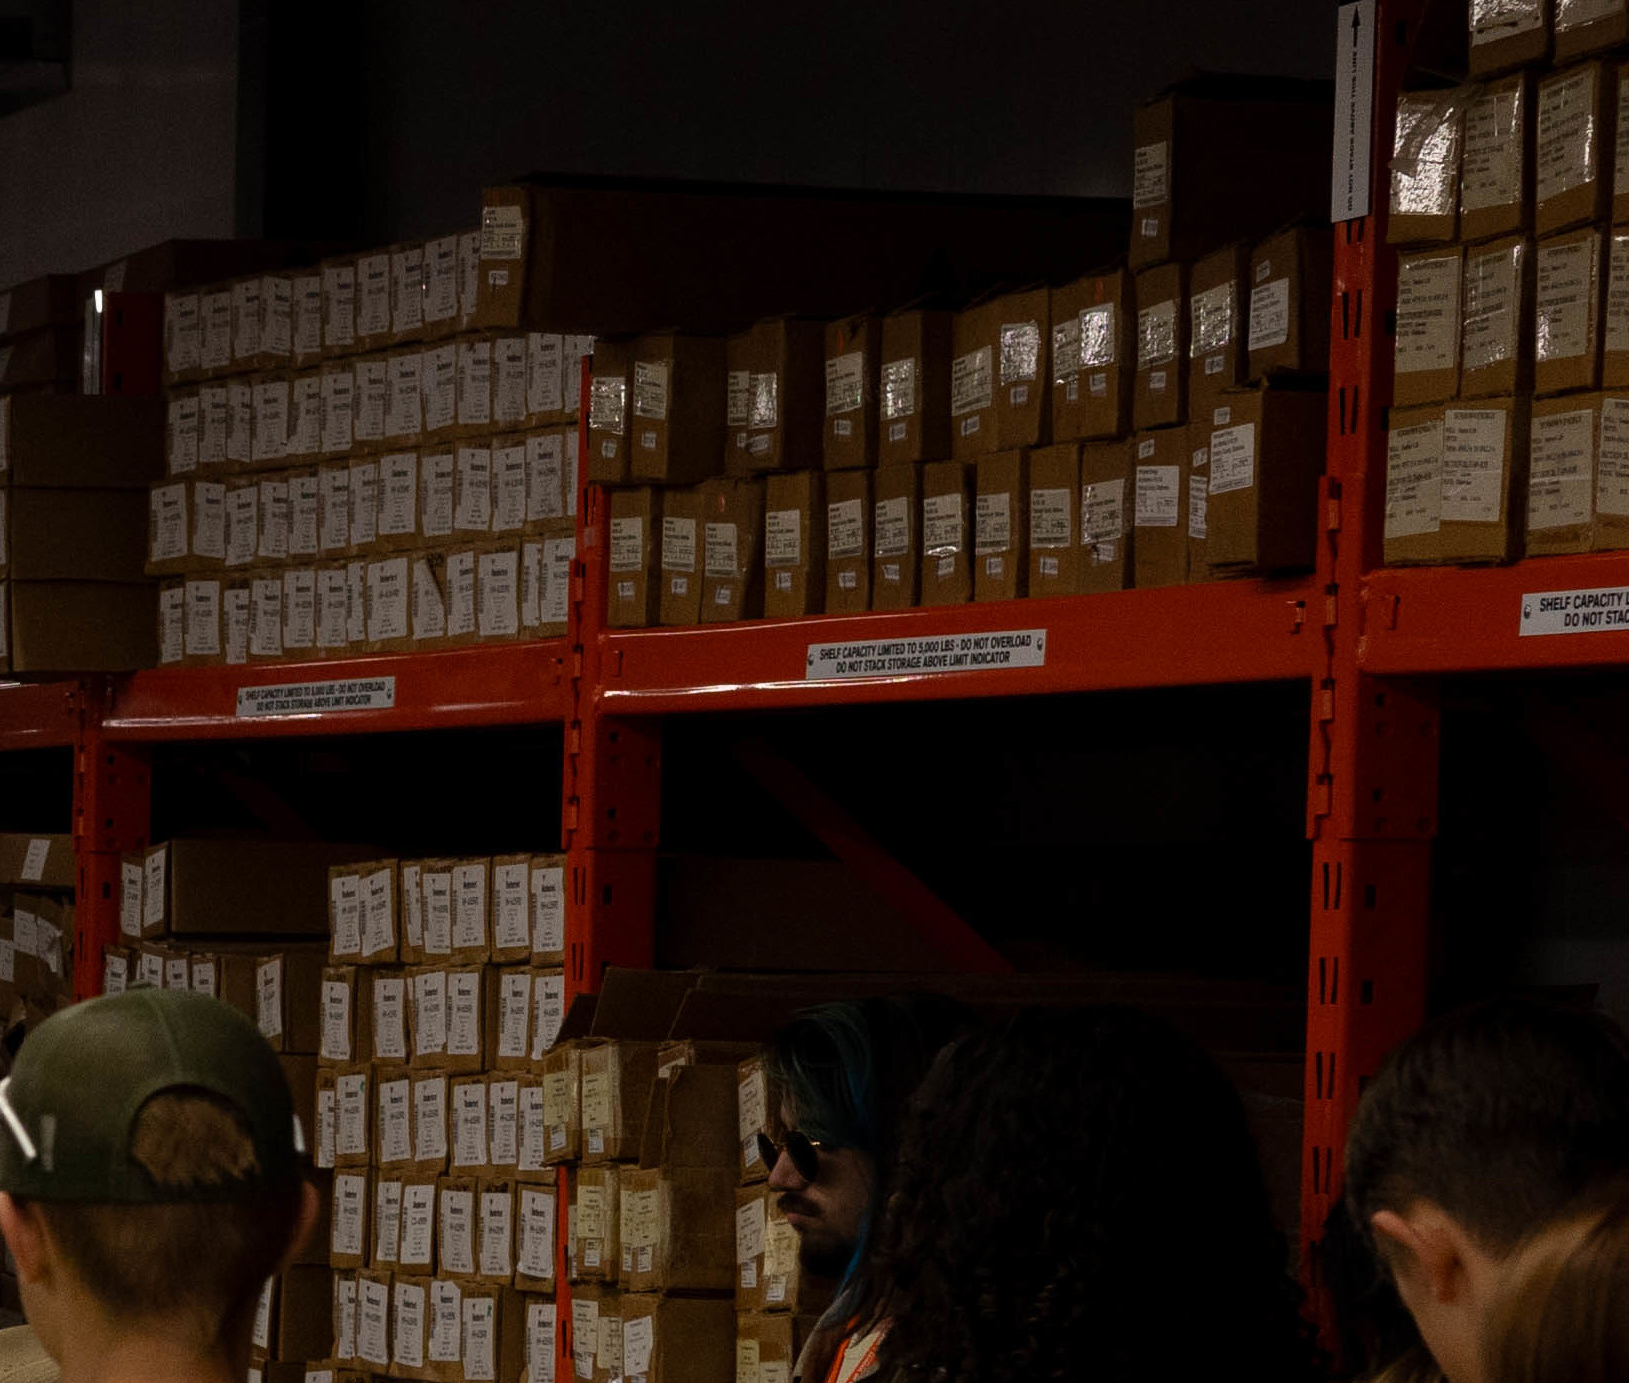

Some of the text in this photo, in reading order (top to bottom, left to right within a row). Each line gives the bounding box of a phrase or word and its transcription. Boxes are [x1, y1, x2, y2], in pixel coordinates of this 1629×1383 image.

[1540, 596, 1571, 612] SHELF
[1573, 591, 1623, 610] CAPACITY
[1564, 609, 1629, 626] DO NOT STAC
[820, 648, 841, 659] SHELF
[843, 645, 876, 658] CAPACITY
[877, 643, 905, 656] LIMITED
[907, 643, 916, 654] TO
[918, 641, 939, 653] 5,000
[941, 640, 955, 652] LBS
[961, 639, 972, 651] DO
[973, 638, 989, 650] NOT
[991, 635, 1031, 649] OVERLOAD
[836, 652, 1010, 673] DO NOT STACK STORAGE ABOVE LIMIT INDICATOR
